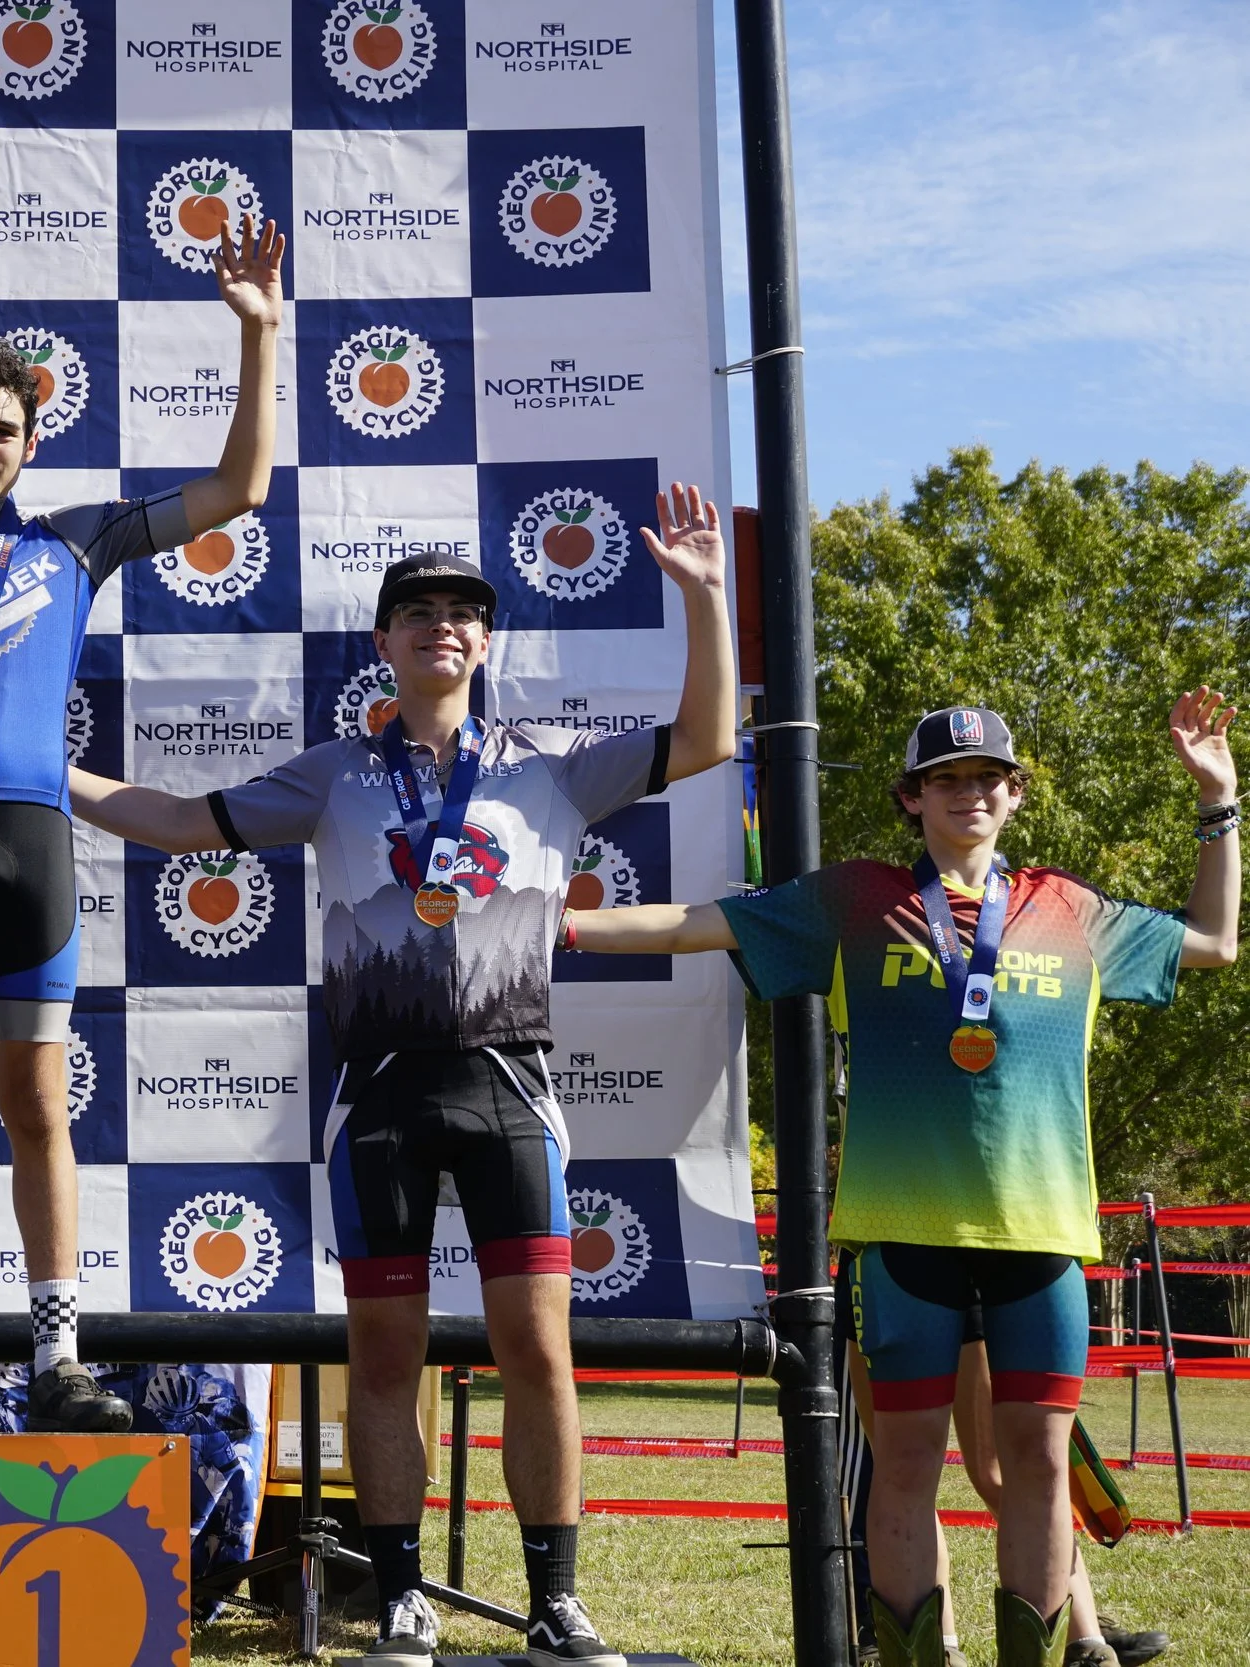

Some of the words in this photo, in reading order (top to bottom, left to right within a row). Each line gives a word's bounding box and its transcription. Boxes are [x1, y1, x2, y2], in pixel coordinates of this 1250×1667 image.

[5, 18, 81, 92] CYCLING
[127, 40, 282, 58] NORTHSIDE
[356, 21, 429, 94] CYCLING
[475, 38, 631, 58] NORTHSIDE
[155, 61, 253, 73] HOSPITAL
[504, 59, 603, 72] HOSPITAL
[153, 165, 227, 237] GEORGIA
[509, 162, 581, 235] GEORGIA
[304, 209, 460, 227] NORTHSIDE
[533, 187, 610, 259] CYCLING
[332, 229, 431, 240] HOSPITAL
[335, 333, 408, 404] GEORGIA
[130, 385, 286, 403] NORTHSE
[362, 358, 436, 430] CYCLING
[484, 373, 644, 396] NORTHSIDE
[158, 405, 232, 417] HOSPIT
[514, 396, 615, 410] HOSPITAL
[518, 494, 593, 565] GEORGIA
[0, 541, 12, 569] CYCLING
[187, 526, 261, 598] CYCLING
[547, 520, 623, 593] CYCLING
[343, 668, 395, 740] GEORG
[134, 723, 293, 741] NORTHSIDE
[163, 743, 264, 756] HOSPITAL
[460, 730, 474, 762] GEORGIA
[394, 769, 411, 811] GEORGIA
[191, 873, 268, 950] CYCLING
[416, 900, 457, 908] GEORGIA
[424, 908, 449, 916] CYCLING
[933, 921, 951, 964] GEORGIA
[46, 981, 70, 990] PRIMAL
[953, 1045, 993, 1053] GEORGIA
[138, 1076, 298, 1095] NORTHSIDE
[551, 1071, 663, 1089] RTHSIDE
[167, 1098, 269, 1110] HOSPITAL
[553, 1092, 634, 1104] OSPITAL
[168, 1199, 245, 1274] GEORGIA
[197, 1228, 276, 1302] CYCLING
[571, 1225, 645, 1295] CYCLING
[386, 1273, 413, 1281] PRIMAL
[34, 1334, 59, 1348] ANS
[584, 1443, 643, 1455] SPECIALIZED
[222, 1594, 242, 1606] SPORT
[243, 1601, 274, 1615] MECHANIC
[26, 1570, 61, 1667] 1
